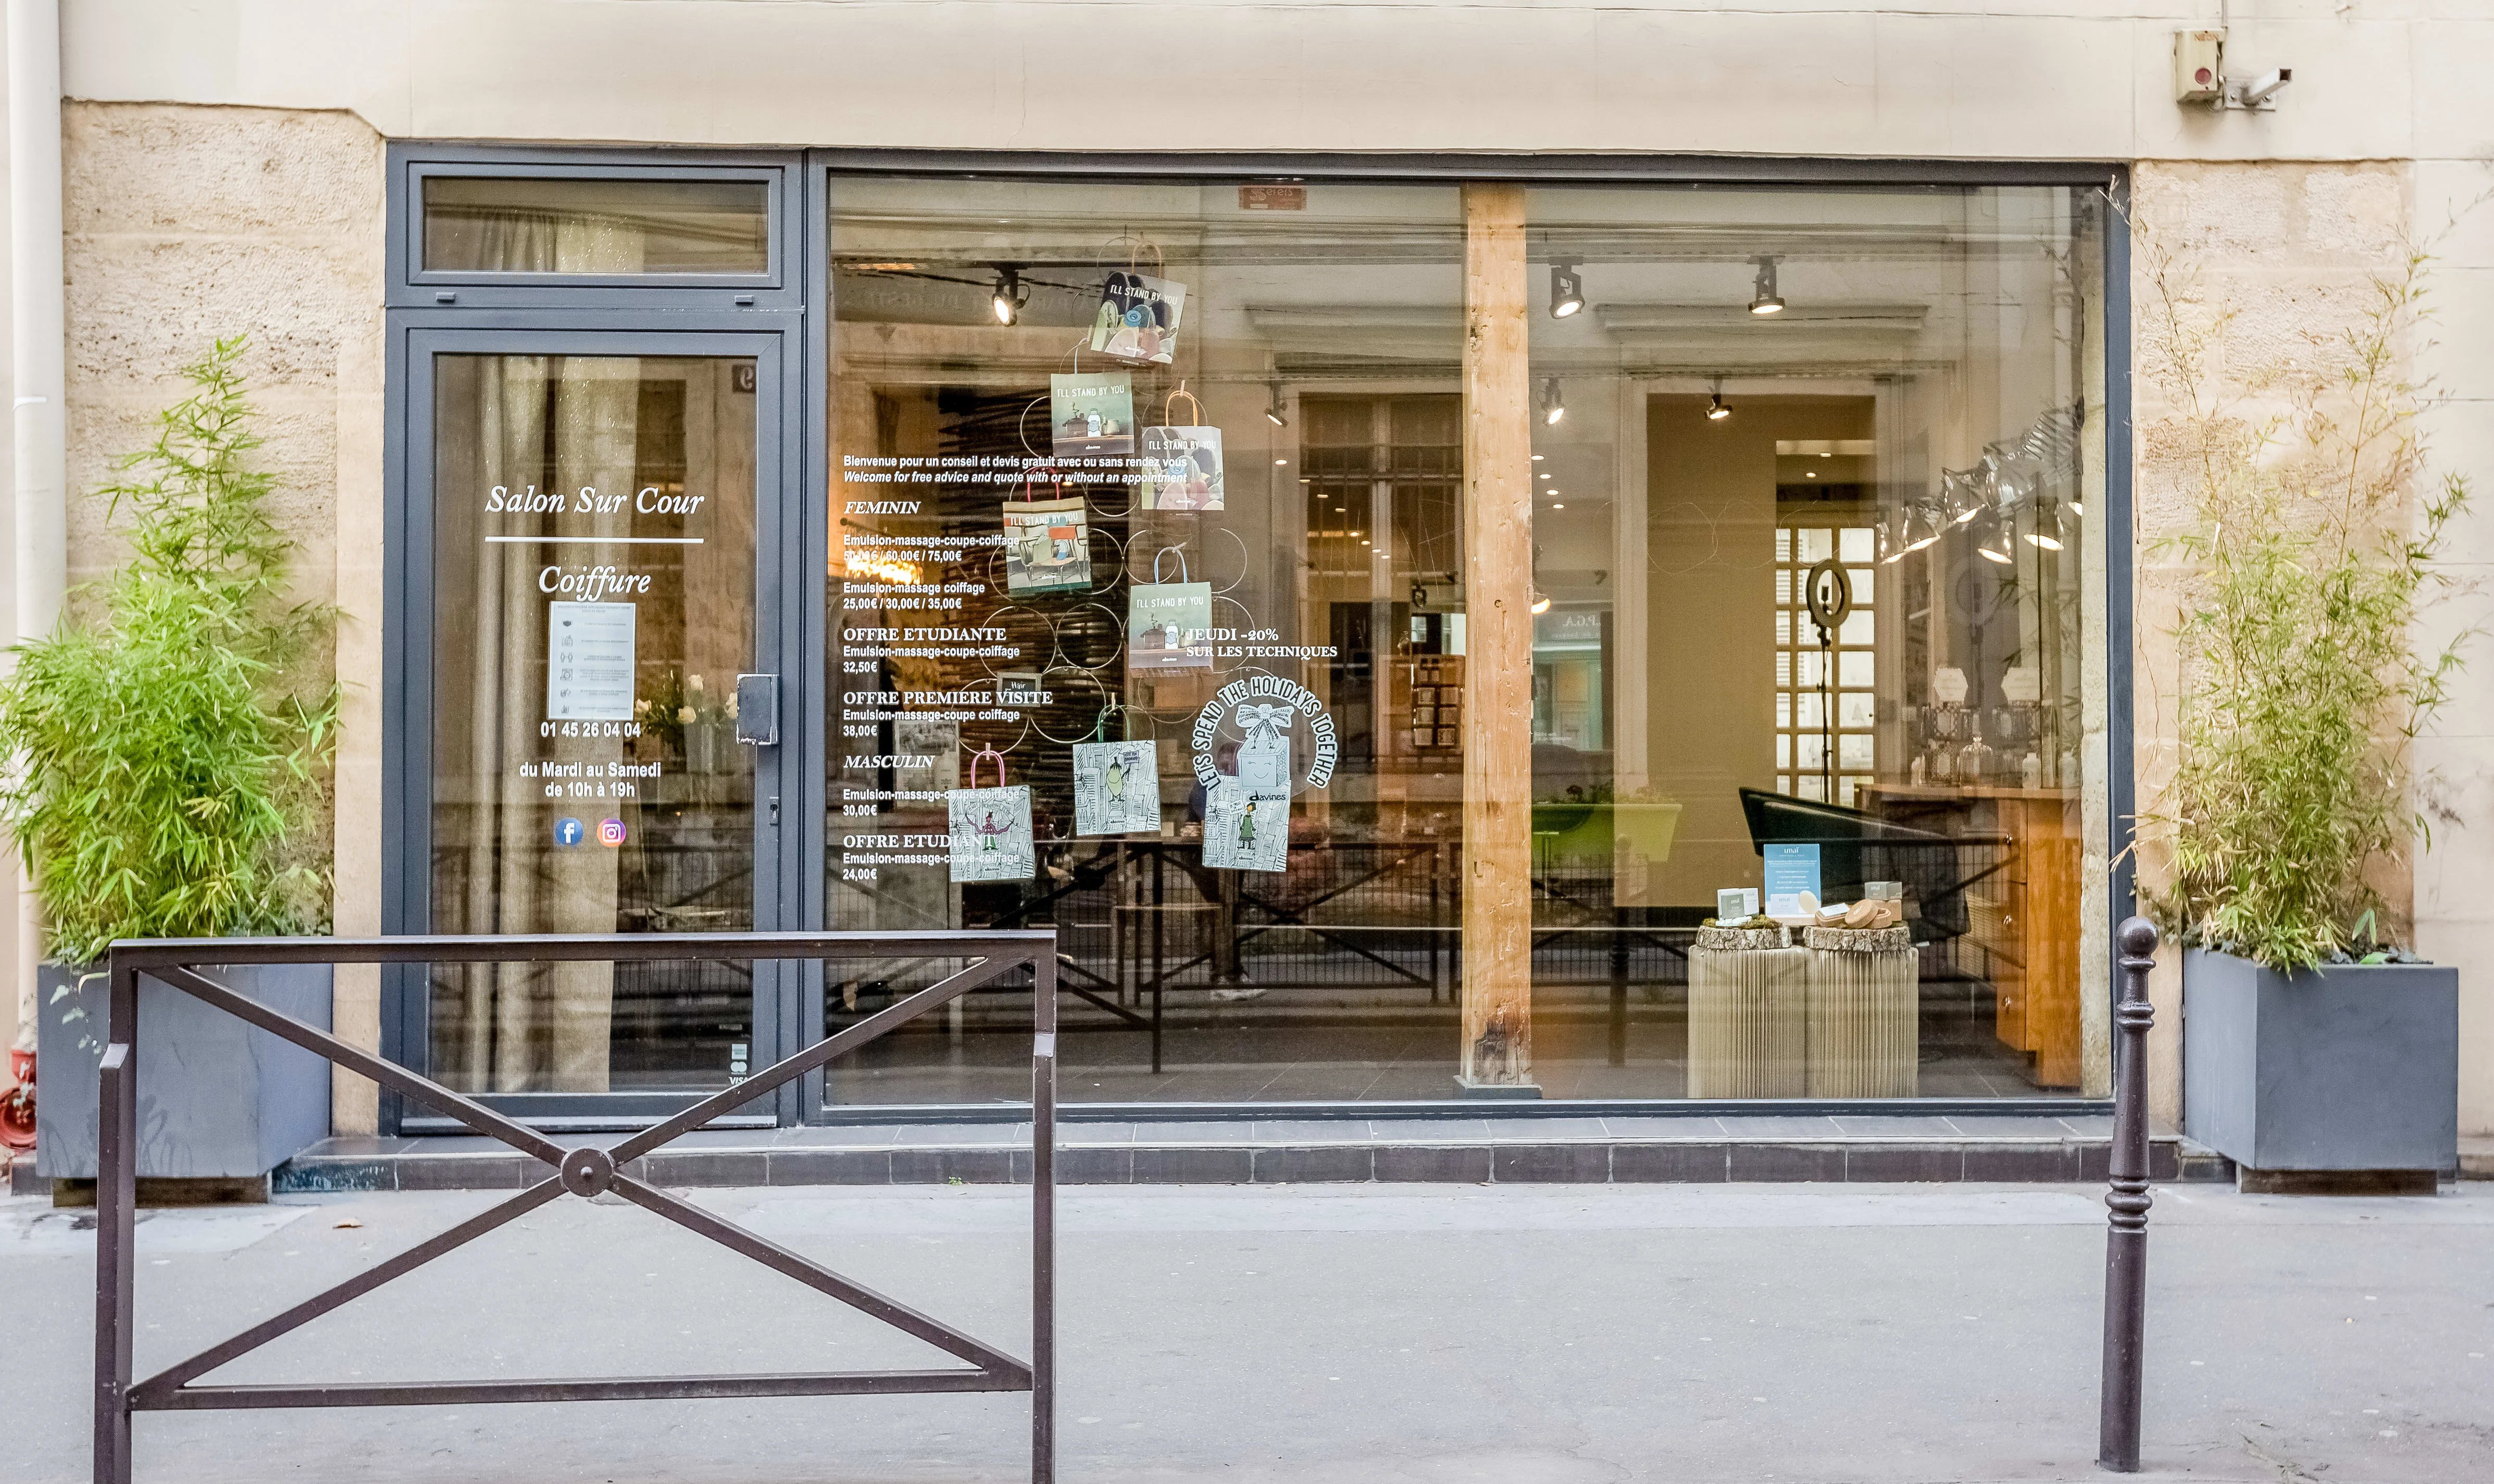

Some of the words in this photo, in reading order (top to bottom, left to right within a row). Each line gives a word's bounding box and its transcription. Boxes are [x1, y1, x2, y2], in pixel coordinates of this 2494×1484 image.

[1110, 284, 1122, 294] I'LL
[1125, 288, 1149, 300] STAND
[1151, 292, 1163, 302] BY
[1164, 293, 1178, 305] YOU
[1057, 389, 1069, 397] I'LL
[1072, 387, 1096, 397] STAND
[1099, 386, 1109, 396] BY
[1111, 385, 1125, 394] YOU
[1149, 441, 1161, 450] I'LL
[1163, 441, 1188, 450] STAND
[1190, 440, 1200, 450] BY
[1202, 440, 1216, 450] YOU
[844, 455, 897, 467] Bienvenue
[900, 457, 923, 469] pour
[926, 457, 939, 467] un
[942, 455, 978, 467] conseil
[980, 456, 990, 467] et
[993, 455, 1020, 467] devis
[1022, 455, 1055, 469] gratuit
[1057, 457, 1081, 467] avec
[1083, 457, 1096, 467] ou
[1099, 457, 1123, 467] sans
[1126, 455, 1159, 467] rendez
[1162, 457, 1187, 467] vous
[844, 471, 892, 483] Welcome
[894, 471, 909, 483] for
[911, 471, 932, 483] free
[934, 471, 969, 483] advice
[971, 471, 992, 483] and
[994, 472, 1024, 485] quote
[1026, 471, 1048, 483] with
[1051, 473, 1062, 483] or
[1065, 471, 1104, 483] without
[1105, 473, 1119, 483] an
[1122, 472, 1187, 485] appointment
[485, 485, 566, 513] Salon
[574, 486, 626, 514] Sur
[636, 488, 704, 515] Cour
[844, 501, 921, 514] FEMININ
[1010, 515, 1023, 525] I'LL
[1025, 514, 1049, 524] STAND
[1052, 513, 1062, 523] BY
[1064, 512, 1078, 522] YOU
[844, 535, 1020, 546] Emulsion-massage-coupe-coiffage
[844, 550, 878, 562] 5000€
[921, 551, 926, 560] /
[928, 550, 962, 563] 75,00€
[539, 566, 651, 601] Coiffure
[844, 583, 941, 594] Emulsion-massage
[944, 583, 985, 594] coiffage
[843, 598, 878, 610] 25,00€
[886, 598, 920, 610] 30,00€
[921, 598, 926, 609] /
[928, 598, 962, 610] 35,00€
[1137, 599, 1149, 608] I'LL
[1151, 598, 1175, 607] STAND
[1178, 597, 1187, 606] BY
[1190, 596, 1204, 605] YOU
[843, 628, 899, 641] OFFRE
[904, 628, 1006, 641] ETUDIANTE
[1186, 628, 1237, 641] JEUDI
[1241, 628, 1278, 641] -20%
[843, 646, 1019, 657] Emulsion-massage-coupe-coiffage
[1186, 646, 1214, 657] SUR
[1217, 646, 1242, 657] LES
[1248, 646, 1337, 660] TECHNIQUES
[843, 662, 877, 674] 32,50€
[1011, 681, 1026, 690] Hair
[843, 692, 899, 704] OFFRE
[904, 692, 992, 704] PREMIERE
[996, 692, 1053, 704] VISITE
[843, 710, 975, 721] Emulsion-massage-coupe
[979, 710, 1019, 721] coiffage
[541, 722, 557, 738] 01
[562, 722, 578, 738] 45
[583, 722, 600, 738] 26
[604, 722, 620, 738] 04
[625, 722, 641, 738] 04
[843, 725, 877, 737] 38,00€
[1193, 703, 1223, 749] SPEND
[1219, 682, 1248, 705] THE
[1252, 678, 1319, 715] HOLIDAYS
[1309, 715, 1336, 787] TOGETHER
[843, 755, 935, 768] MASCULIN
[520, 763, 538, 777] du
[542, 763, 582, 777] Mardi
[587, 765, 604, 777] au
[608, 763, 661, 777] Samedi
[545, 782, 563, 797] de
[568, 782, 593, 797] 10h
[597, 782, 605, 797] à
[610, 782, 635, 797] 19h
[843, 789, 1019, 801] Emulsion-massage-coupe-coiffage
[1249, 790, 1286, 801] davines
[843, 805, 877, 816] 30,00€
[843, 835, 899, 847] OFFRE
[904, 835, 993, 847] ETUDIANT
[843, 854, 1019, 865] Emulsion-massage-coupe-coiffage
[843, 869, 877, 880] 24,00€
